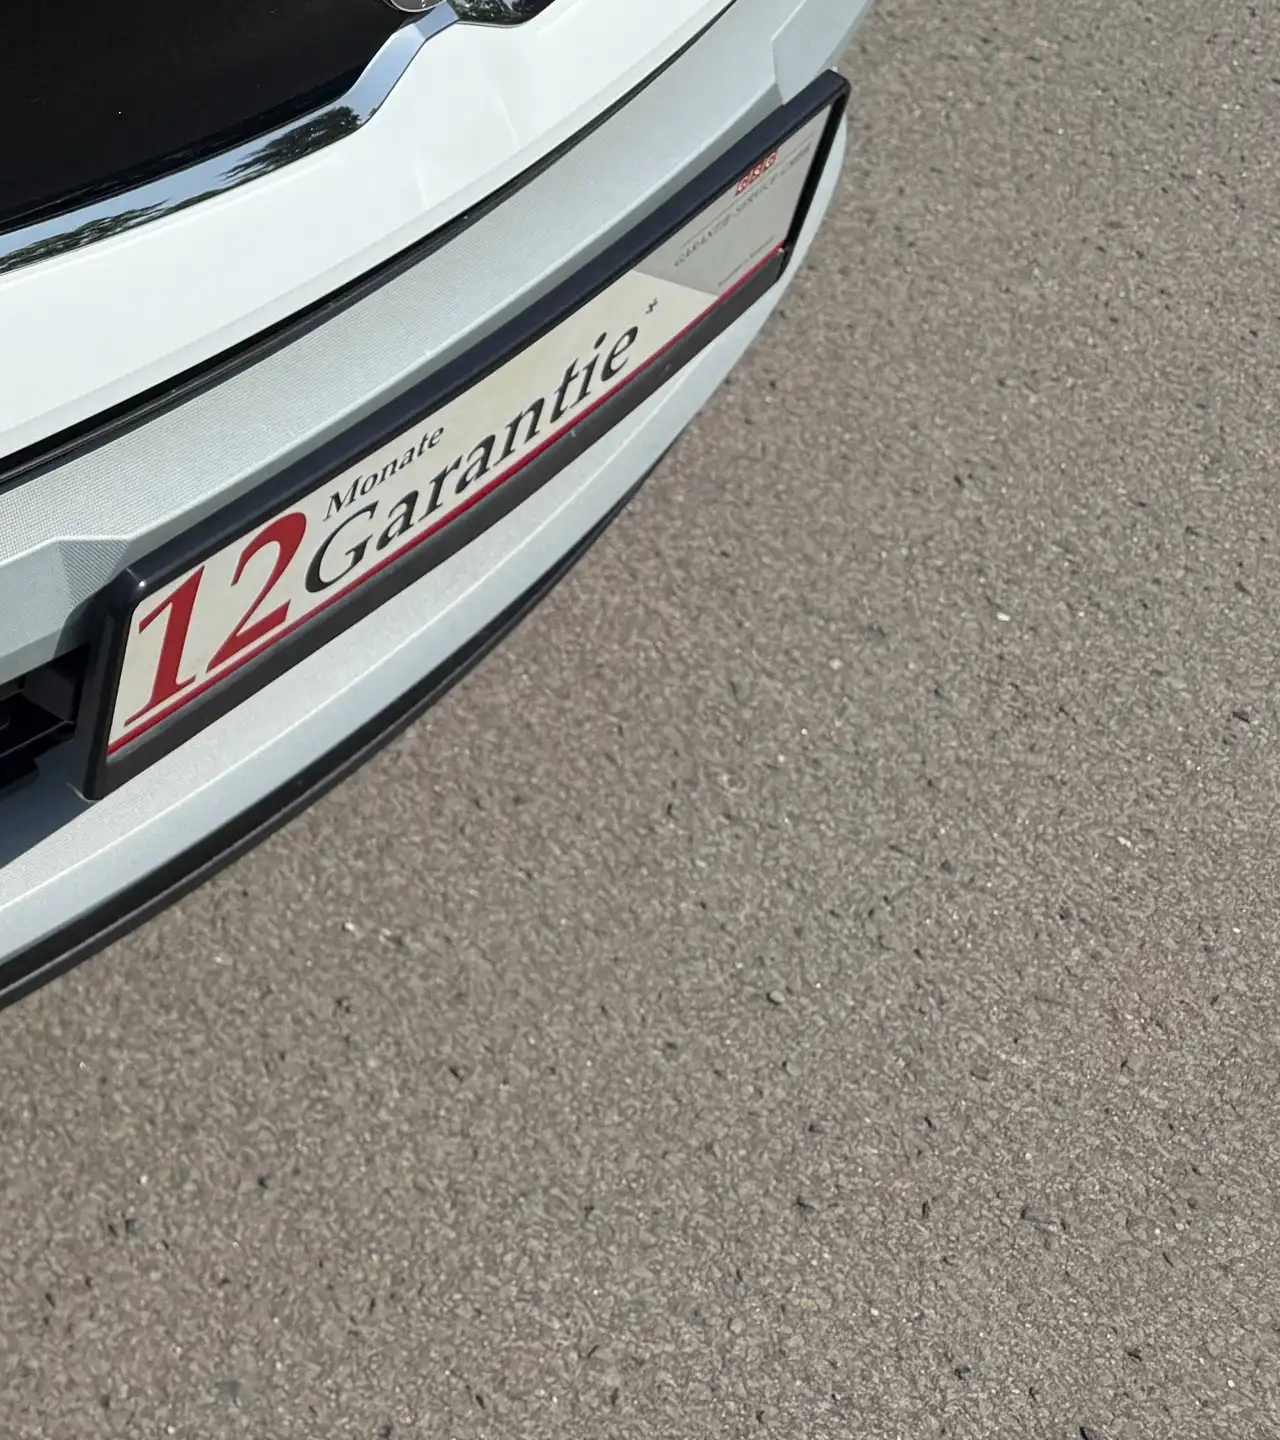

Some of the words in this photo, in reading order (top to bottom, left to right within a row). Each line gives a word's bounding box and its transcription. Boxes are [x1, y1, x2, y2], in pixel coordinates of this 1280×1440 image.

[304, 325, 639, 594] Garantie
[323, 426, 445, 523] Monate
[123, 511, 307, 728] 12
